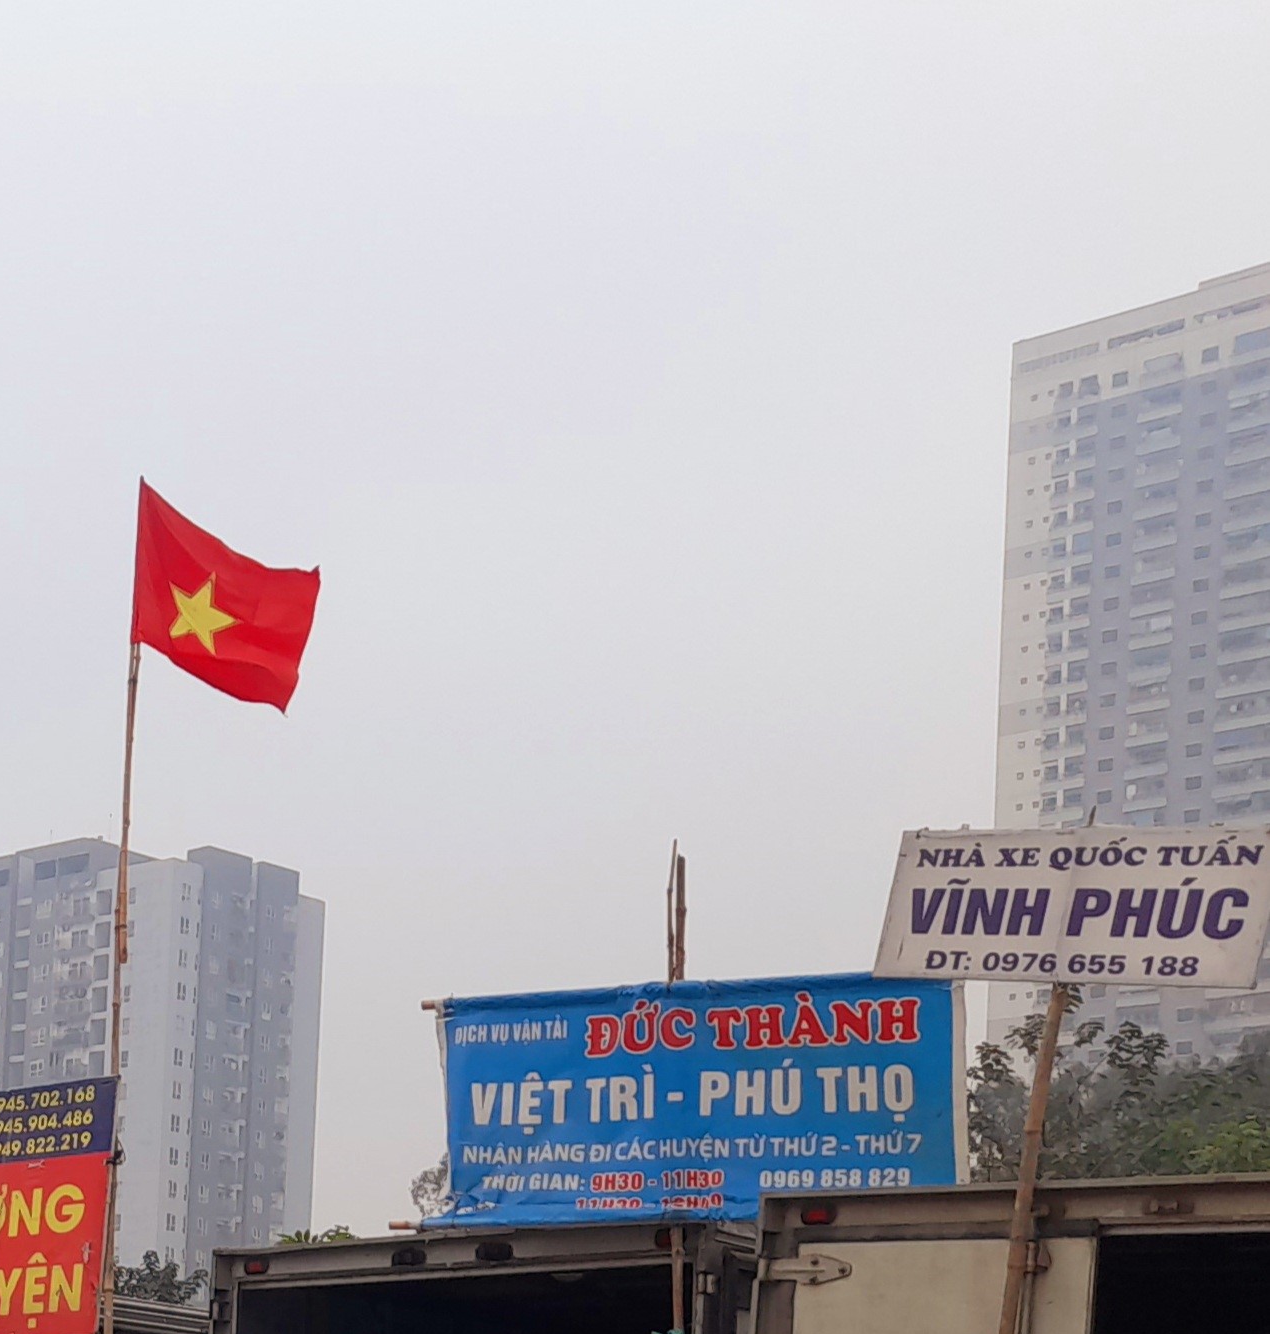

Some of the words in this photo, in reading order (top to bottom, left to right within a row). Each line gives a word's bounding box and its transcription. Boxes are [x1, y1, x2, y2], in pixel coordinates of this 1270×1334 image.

[917, 842, 985, 868] NHÀ
[995, 848, 1040, 867] XE
[1049, 836, 1147, 870] QUỐC
[1157, 835, 1264, 867] TUẤN
[911, 878, 1051, 936] VĨNH
[1066, 877, 1249, 940] PHÚC
[925, 950, 970, 970] ĐT:
[983, 952, 1056, 973] 0976
[1068, 954, 1126, 975] 655
[1141, 955, 1200, 976] 188
[455, 1025, 487, 1047] DỊCH
[492, 1024, 508, 1046] VỤ
[512, 1019, 541, 1045] VẬN
[545, 1014, 568, 1039] TẢI
[585, 1000, 696, 1058] ĐỨC
[708, 992, 921, 1050] THÀNH
[471, 1071, 572, 1135] VIỆT
[585, 1063, 655, 1123] TRÌ
[699, 1059, 803, 1117] PHÚ
[816, 1064, 914, 1122] THỌ
[462, 1142, 522, 1169] NHẬN
[527, 1141, 585, 1165] HÀNG
[589, 1144, 611, 1163] ĐI
[615, 1136, 656, 1161] CÁC
[659, 1133, 729, 1163] HUYỆN
[734, 1133, 766, 1158] TỪ
[770, 1131, 818, 1157] THỨ
[821, 1136, 838, 1156] 2
[855, 1129, 904, 1155] THỨ
[907, 1134, 922, 1155] 7
[528, 1173, 585, 1192] GIAN:
[590, 1171, 644, 1193] 9H30
[661, 1168, 725, 1190] 11H30
[760, 1169, 814, 1188] 0969
[820, 1168, 862, 1188] 858
[868, 1167, 910, 1187] 829
